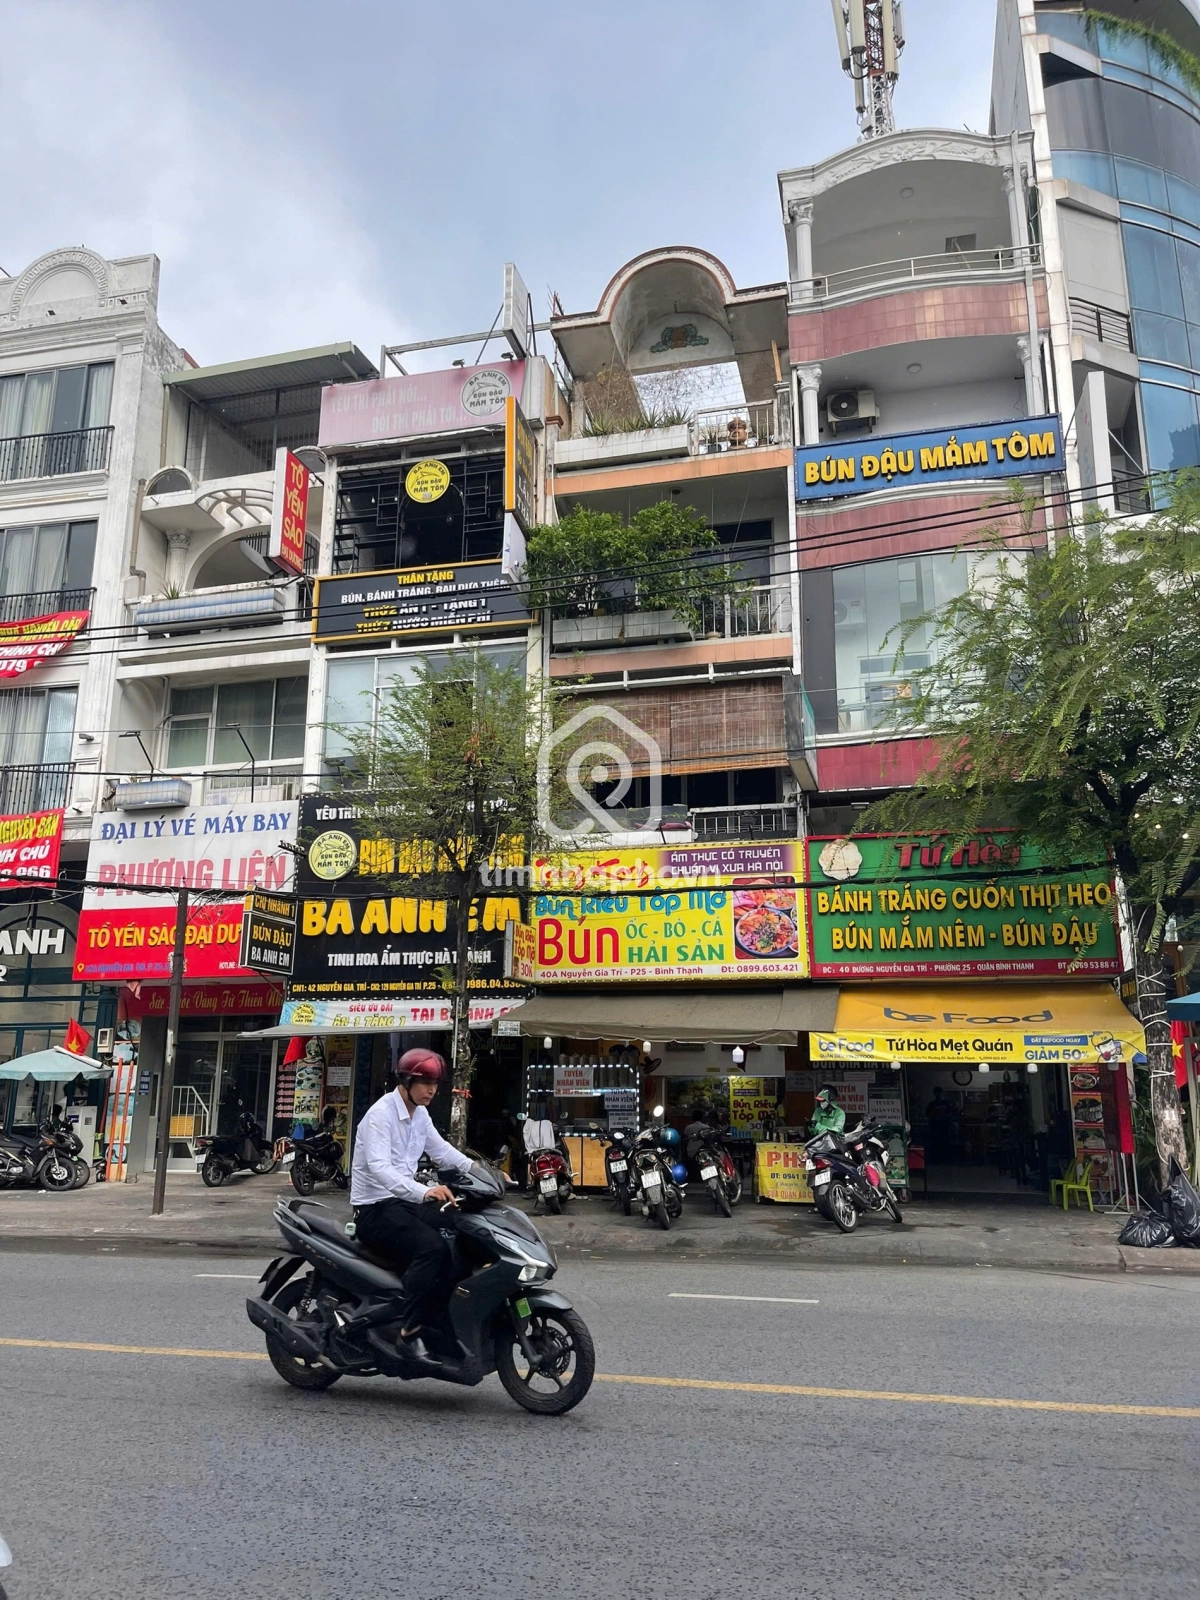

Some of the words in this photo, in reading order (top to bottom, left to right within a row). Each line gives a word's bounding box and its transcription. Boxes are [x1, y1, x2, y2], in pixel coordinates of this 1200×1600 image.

[804, 454, 855, 485] BÚN
[861, 447, 915, 481] ĐẬU
[919, 436, 989, 471] MẮM
[991, 431, 1056, 461] TÔM
[291, 461, 304, 490] TỔ
[286, 487, 304, 521] YẾN
[397, 573, 425, 585] THÂN
[426, 571, 454, 583] TẶNG
[367, 589, 395, 601] BÁNH
[315, 804, 337, 820] YÊU
[101, 822, 137, 845] ĐẠI
[143, 815, 166, 838] LÝ
[170, 813, 196, 836] VÉ
[203, 810, 248, 835] MÁY
[252, 812, 292, 833] BAY
[19, 840, 50, 861] CHỦ
[894, 834, 945, 869] Tứ
[221, 849, 287, 890] LIÊN
[817, 884, 873, 914] BÁNH
[877, 882, 947, 913] TRÁNG
[952, 877, 1014, 910] CUỐN
[1019, 883, 1061, 914] THỊT
[1067, 882, 1112, 906] HEO
[291, 904, 296, 918] 1
[302, 896, 354, 936] BA
[360, 896, 448, 935] ANH
[88, 922, 111, 949] TỔ
[113, 922, 145, 948] YẾN
[185, 924, 213, 950] ĐẠI
[252, 922, 271, 943] BÚN
[273, 927, 292, 949] ĐẬU
[538, 916, 620, 966] Bún
[625, 918, 649, 939] ỐC
[664, 917, 686, 938] BÒ
[701, 916, 724, 937] CÁ
[831, 920, 873, 951] BÚN
[879, 914, 935, 950] MẮM
[938, 917, 985, 948] NÊM
[1002, 917, 1046, 947] BÚN
[1052, 915, 1098, 952] ĐẬU
[251, 946, 261, 962] BA
[262, 949, 278, 965] ANH
[279, 952, 290, 967] EM
[327, 953, 354, 966] TINH
[355, 952, 379, 966] HOA
[381, 944, 400, 965] ẨM
[402, 950, 433, 968] THỰC
[434, 947, 452, 965] HÀ
[628, 940, 668, 964] HẢI
[677, 939, 725, 962] SẢN
[521, 962, 533, 978] 30K
[540, 970, 558, 978] 40A
[560, 967, 592, 979] Nguyễn
[594, 968, 609, 977] Gia
[630, 968, 647, 976] P25
[676, 966, 703, 976] Thạnh
[737, 964, 798, 974] 0899.603.421
[876, 962, 902, 973] NGUYỄN
[903, 964, 915, 972] GIA
[917, 963, 928, 972] TRÍ
[962, 963, 971, 971] 25
[1089, 961, 1099, 969] 53
[1110, 960, 1119, 969] 47
[308, 984, 316, 992] 42
[343, 983, 355, 992] GIA
[423, 981, 436, 990] P.25
[332, 1013, 350, 1026] ĂN
[400, 1016, 406, 1026] 1
[411, 1008, 435, 1024] TẠI
[943, 1009, 1053, 1024] Food
[838, 1038, 874, 1052] Food
[886, 1037, 905, 1051] Tứ
[907, 1037, 937, 1052] Hòa
[940, 1039, 969, 1055] Mẹt
[972, 1039, 1013, 1052] Quán
[1024, 1046, 1060, 1061] GIẢM
[1062, 1049, 1090, 1060] 50%
[556, 1079, 574, 1087] NHÂN
[733, 1099, 752, 1110] Bún
[848, 1094, 865, 1102] VIÊN
